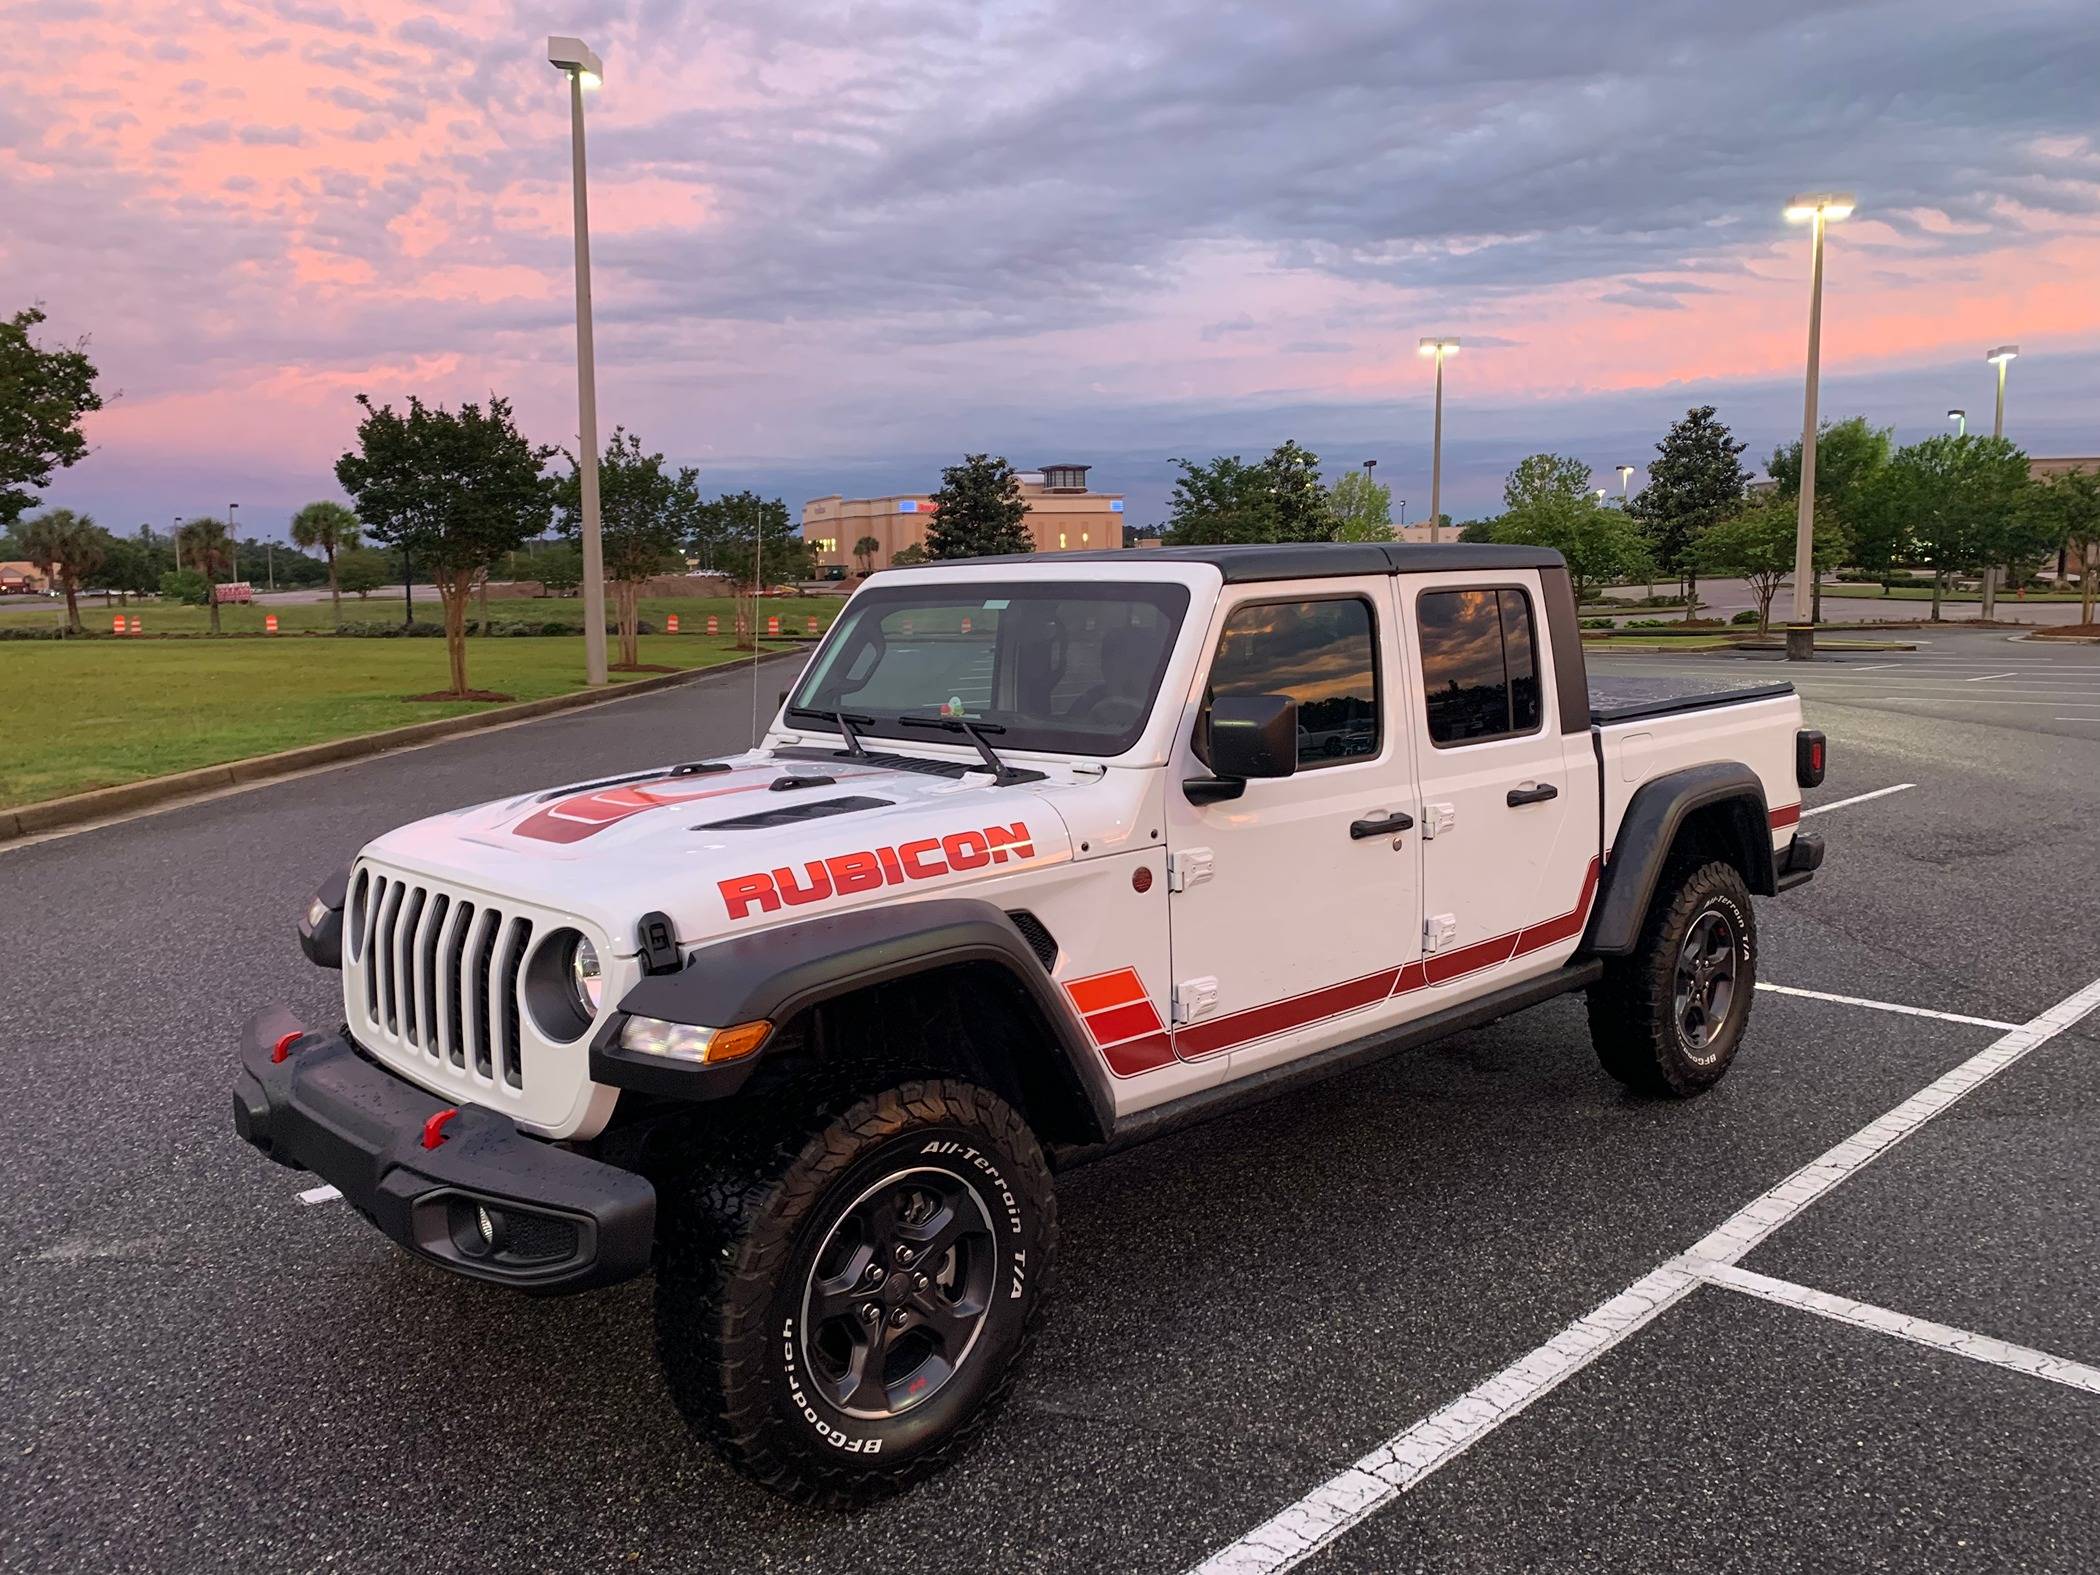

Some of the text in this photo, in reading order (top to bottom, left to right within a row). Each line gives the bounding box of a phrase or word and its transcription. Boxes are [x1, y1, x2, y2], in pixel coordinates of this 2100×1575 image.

[718, 821, 1035, 920] RUBICON
[1704, 895, 1751, 961] All-Terrain T/A
[920, 1141, 1029, 1299] All-Terrain T/A
[780, 1318, 883, 1454] BFGoodrich
